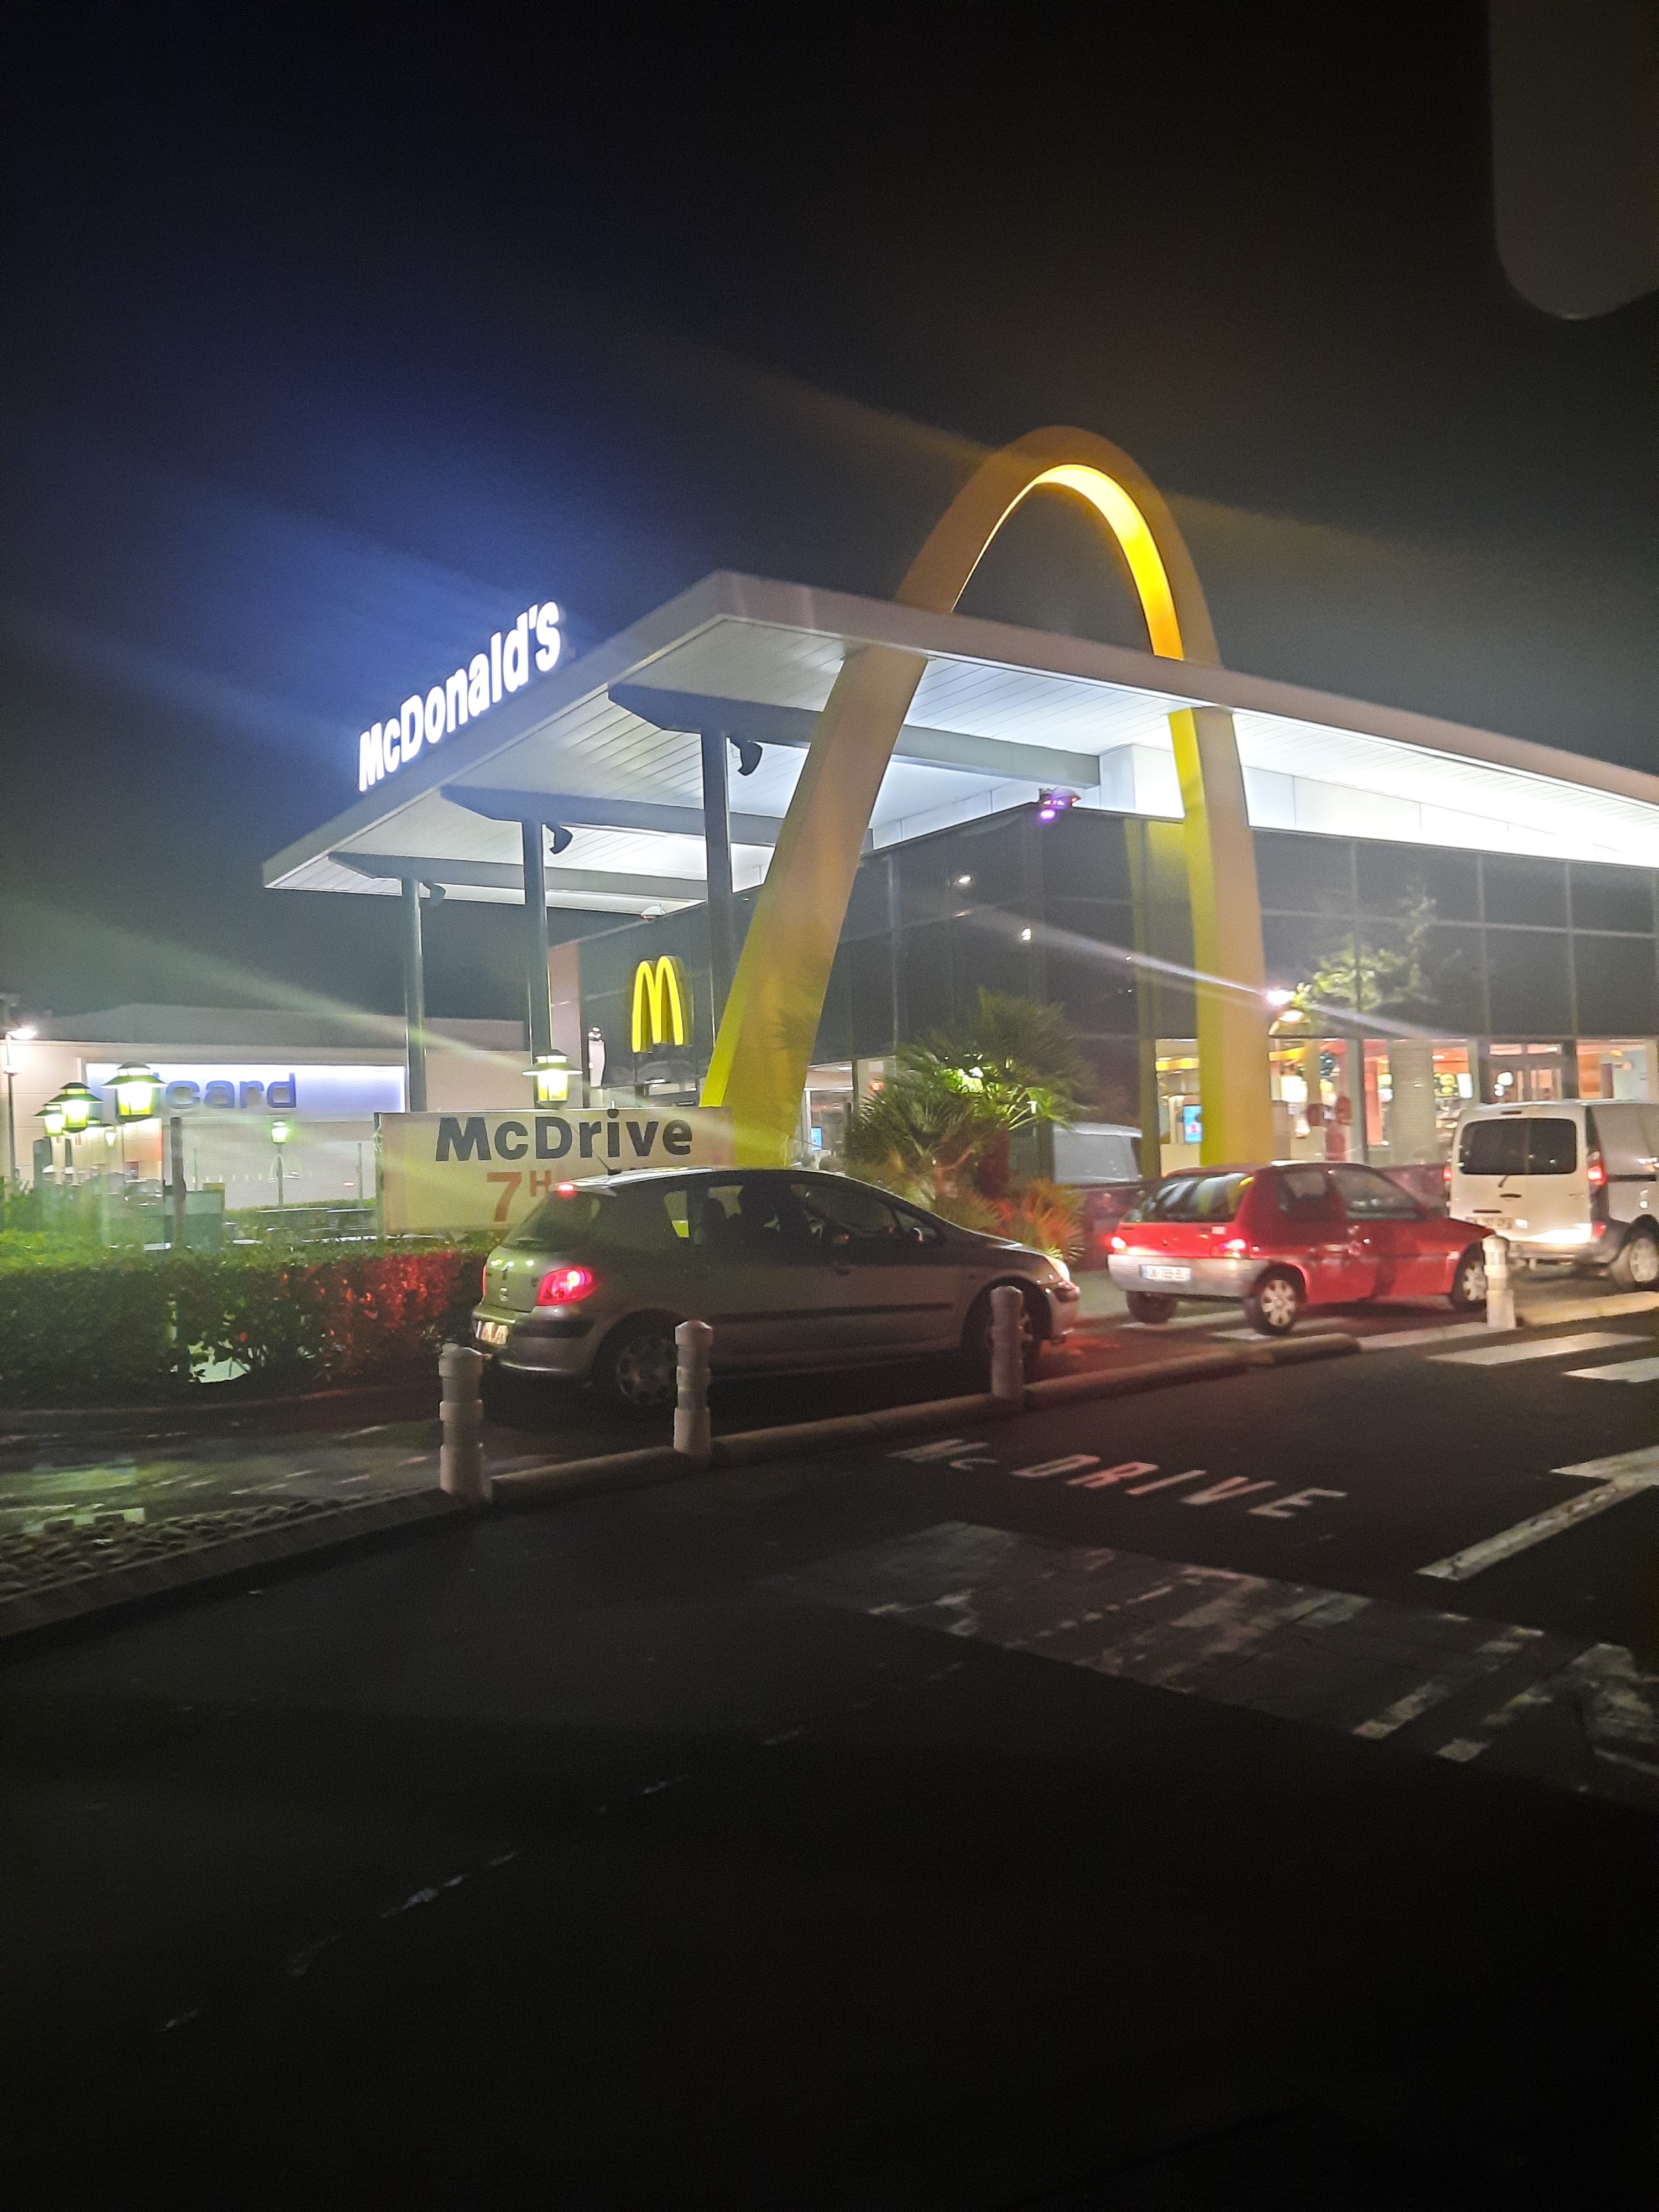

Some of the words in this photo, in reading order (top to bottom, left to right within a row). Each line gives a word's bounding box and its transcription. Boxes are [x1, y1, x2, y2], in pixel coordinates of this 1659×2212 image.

[358, 601, 561, 792] McDonald's
[436, 1108, 693, 1161] McDrive
[1009, 1453, 1348, 1519] DRIVE
